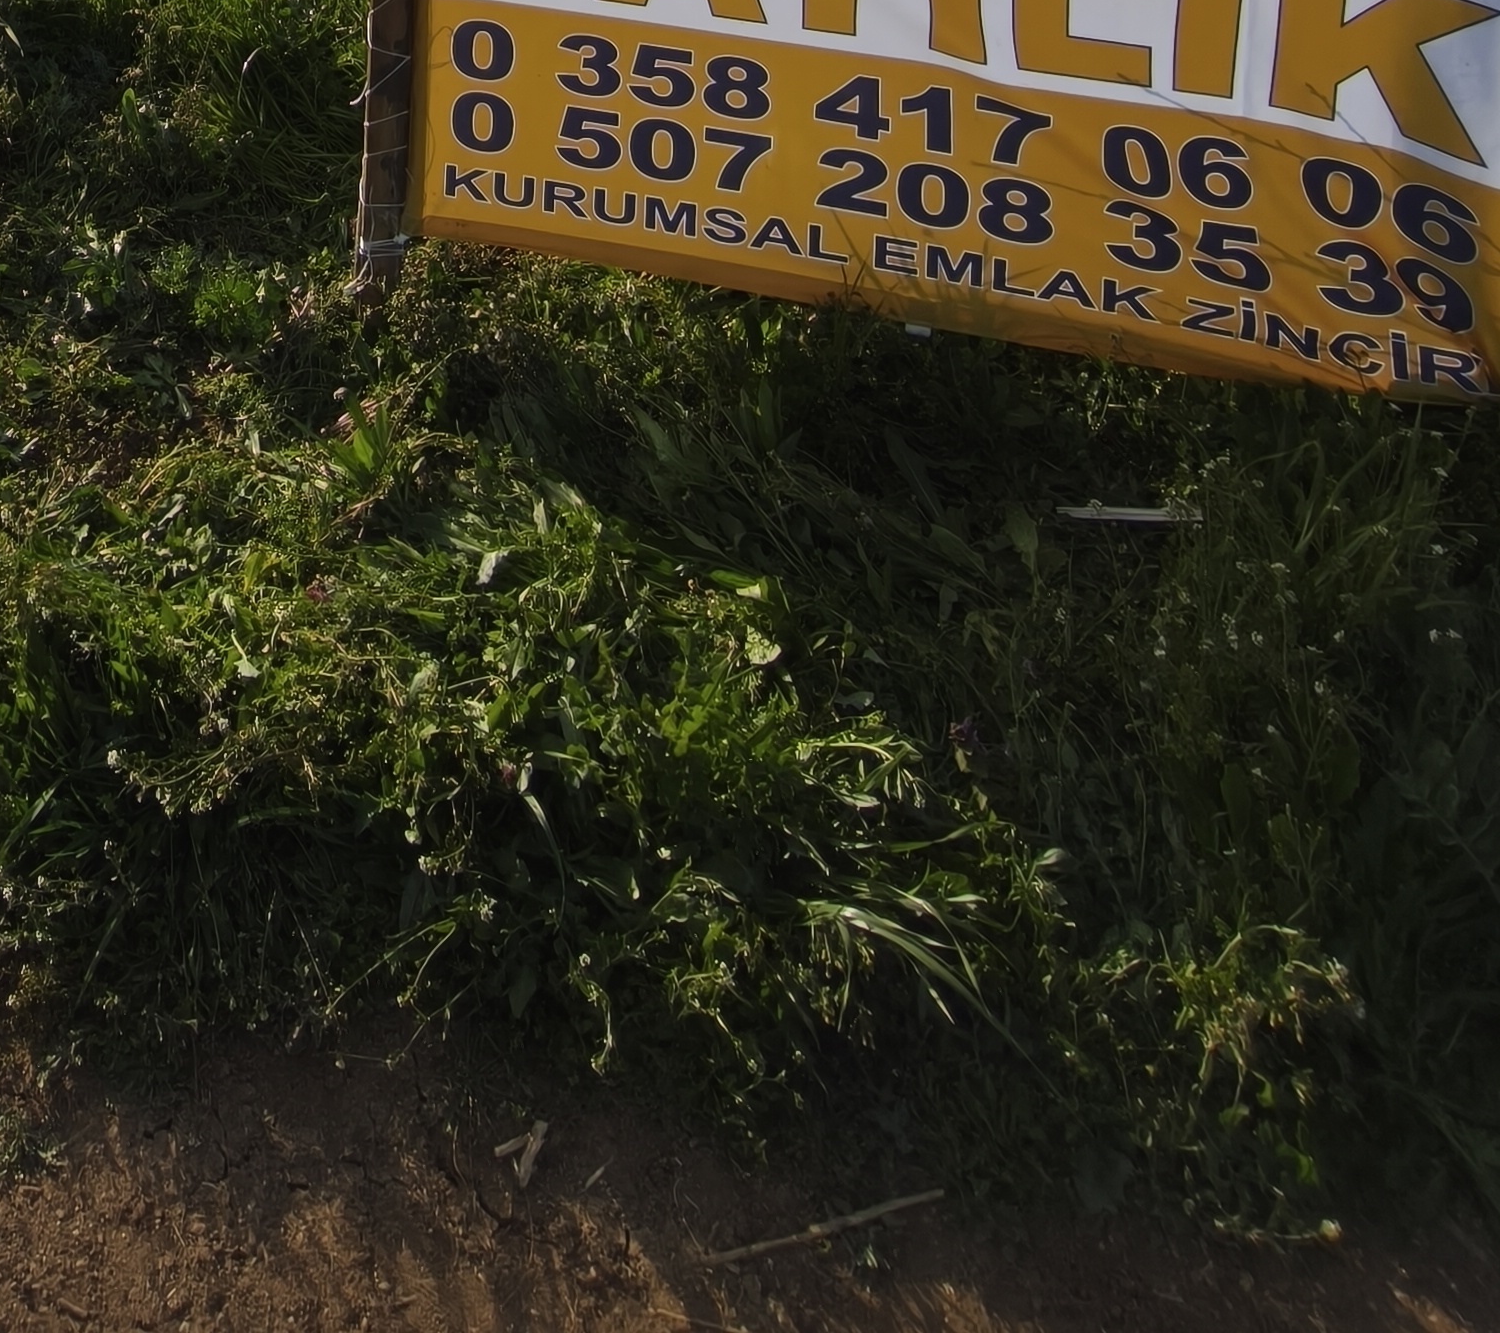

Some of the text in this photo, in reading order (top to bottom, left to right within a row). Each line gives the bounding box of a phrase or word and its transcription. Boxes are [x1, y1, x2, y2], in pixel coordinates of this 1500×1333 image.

[451, 19, 1480, 265] 0 358 417 06 06
[451, 91, 1475, 334] 0 507 208 35 39
[443, 163, 1491, 395] KURUMSAL EMLAK ZİNCİR
